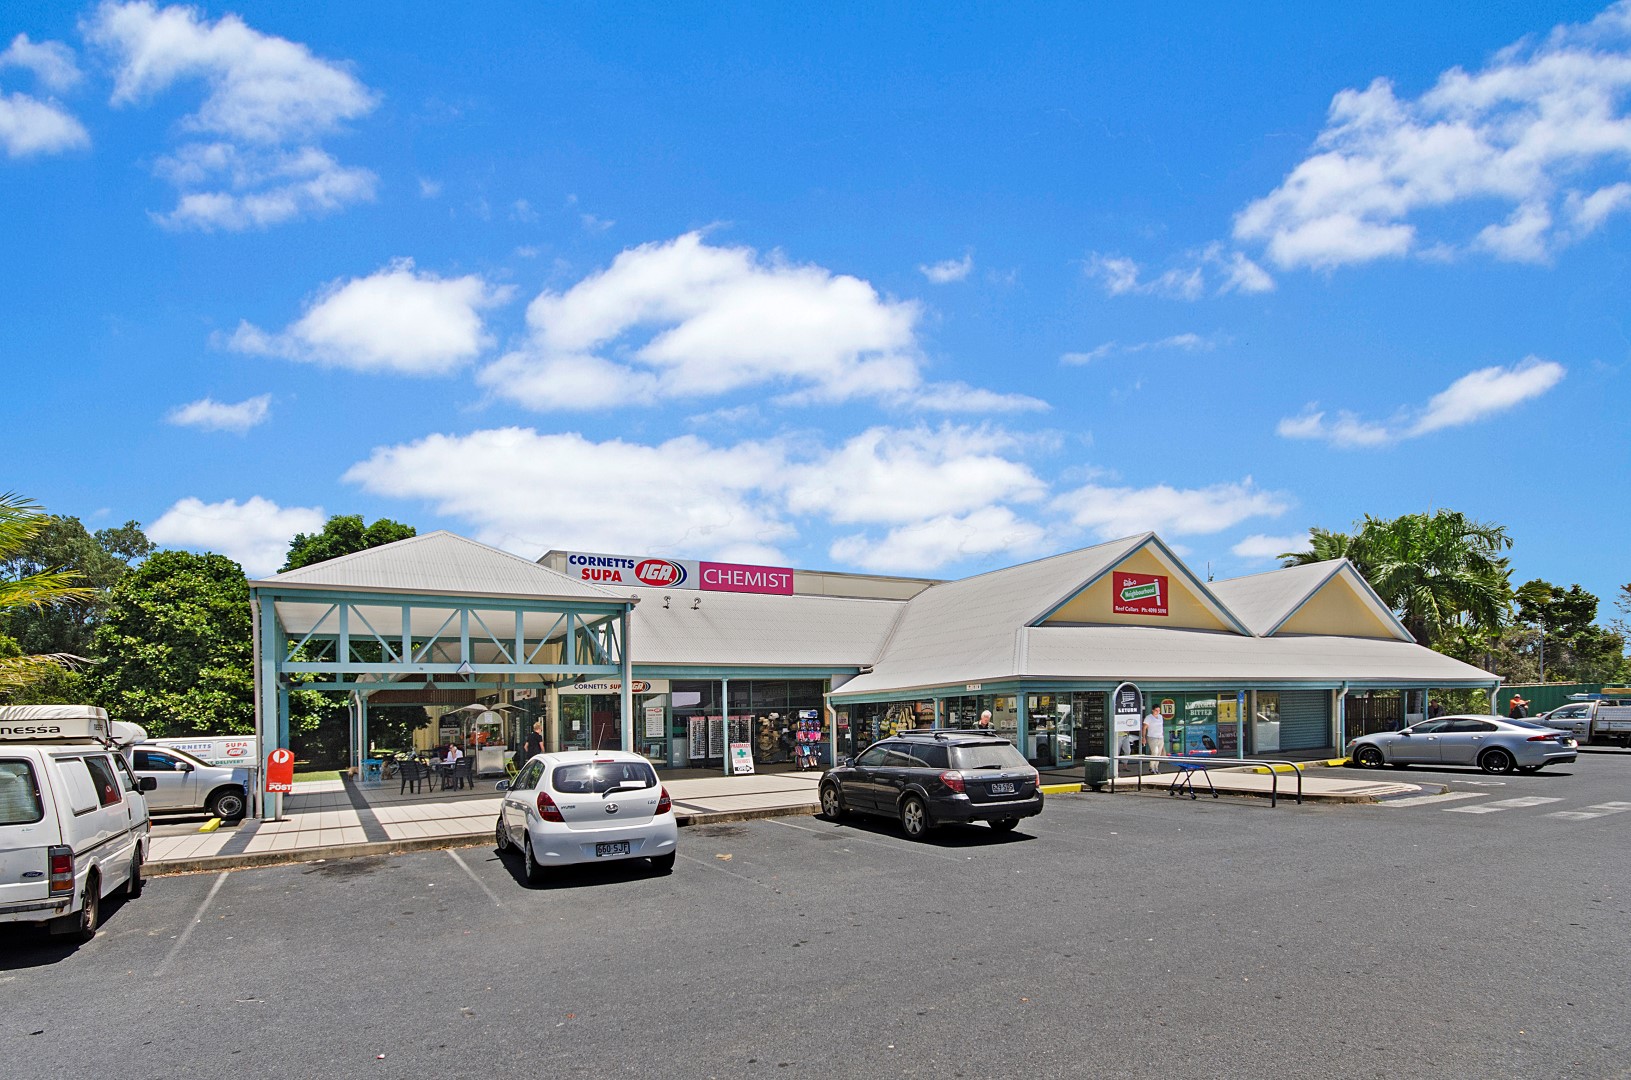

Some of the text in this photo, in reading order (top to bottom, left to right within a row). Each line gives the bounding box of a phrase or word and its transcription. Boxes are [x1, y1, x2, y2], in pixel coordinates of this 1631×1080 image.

[569, 554, 635, 569] CORNETTS
[581, 567, 623, 582] SUPA
[703, 568, 790, 588] CHEMIST
[1125, 587, 1155, 597] Neighbourhood
[1163, 704, 1173, 714] VB
[597, 844, 628, 854] 660 SJF
